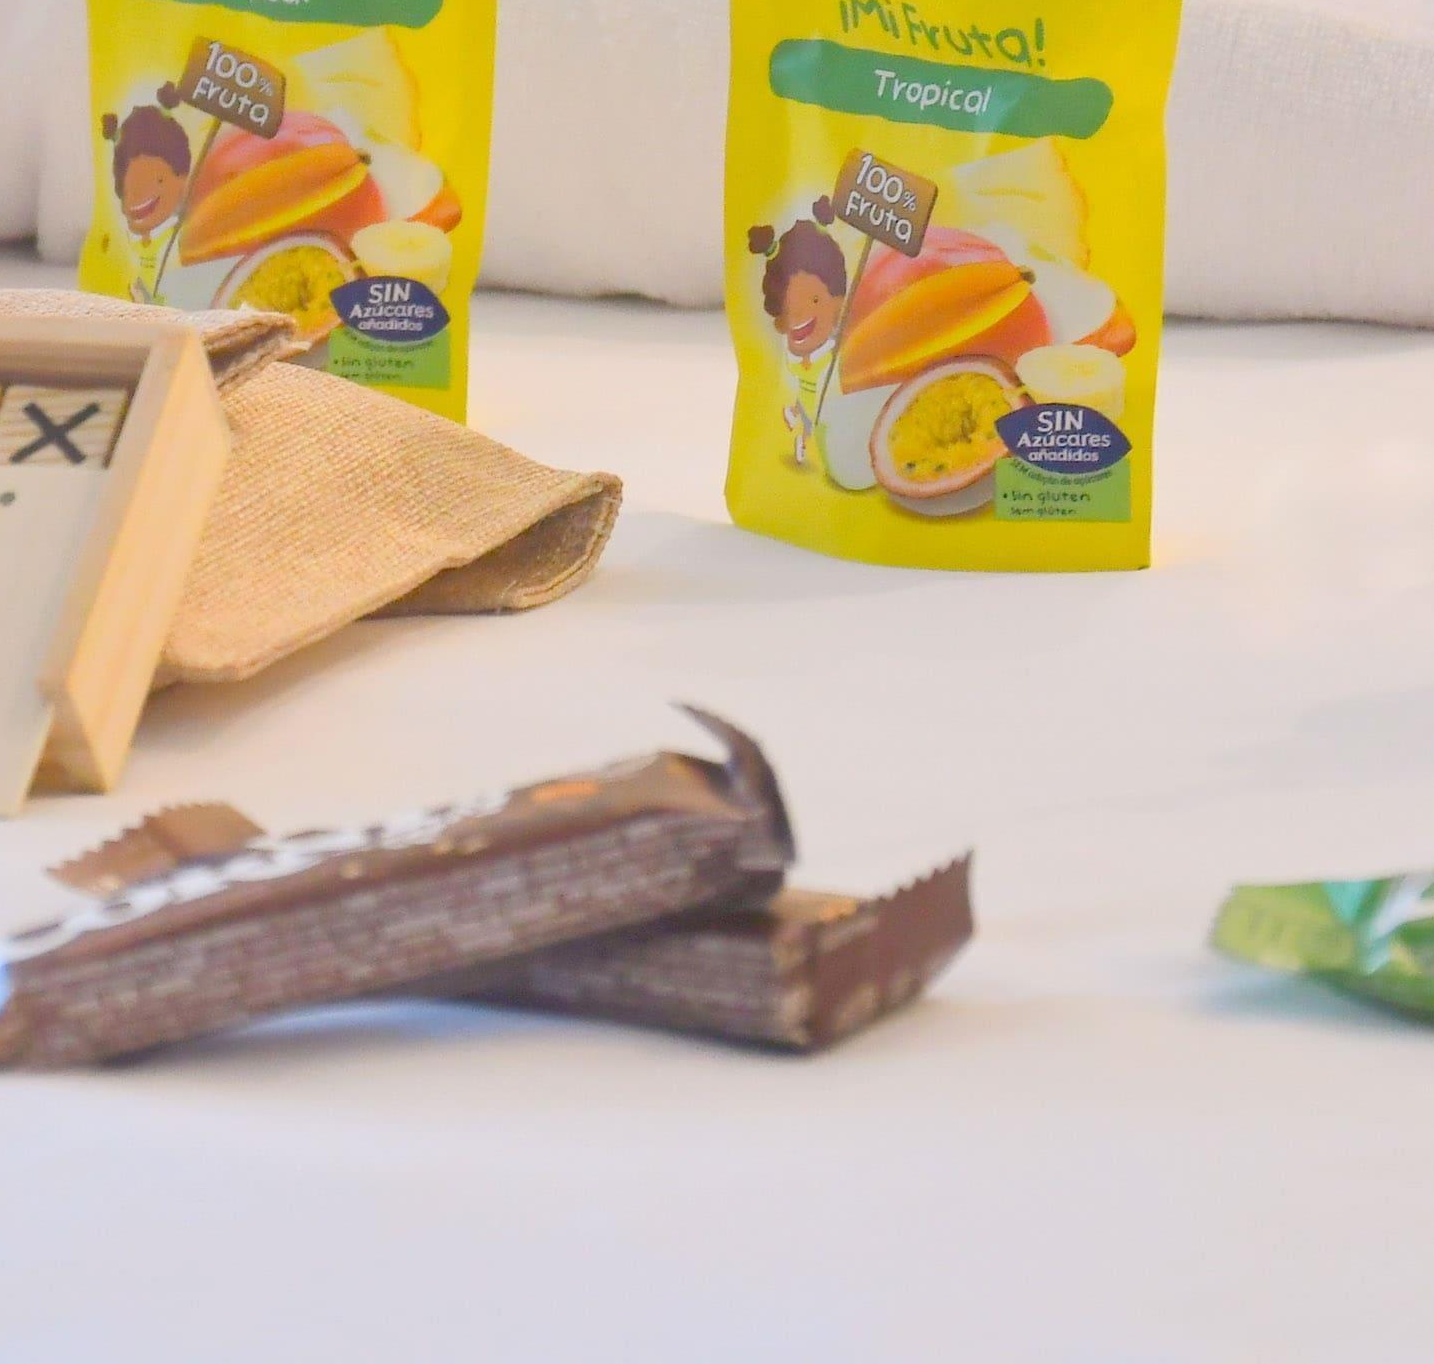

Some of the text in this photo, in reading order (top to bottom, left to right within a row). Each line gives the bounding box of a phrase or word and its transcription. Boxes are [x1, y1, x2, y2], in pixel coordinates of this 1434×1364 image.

[206, 42, 273, 97] 100%
[874, 69, 992, 116] Tropical
[856, 154, 916, 212] 100%
[368, 282, 411, 304] SIN
[349, 302, 434, 318] Azúcares
[358, 318, 423, 331] añadidos
[1037, 410, 1084, 432] SIN
[10, 401, 101, 464] X
[1017, 431, 1111, 448] Azúcares
[1028, 447, 1099, 462] añadidos
[1037, 490, 1091, 504] gluten
